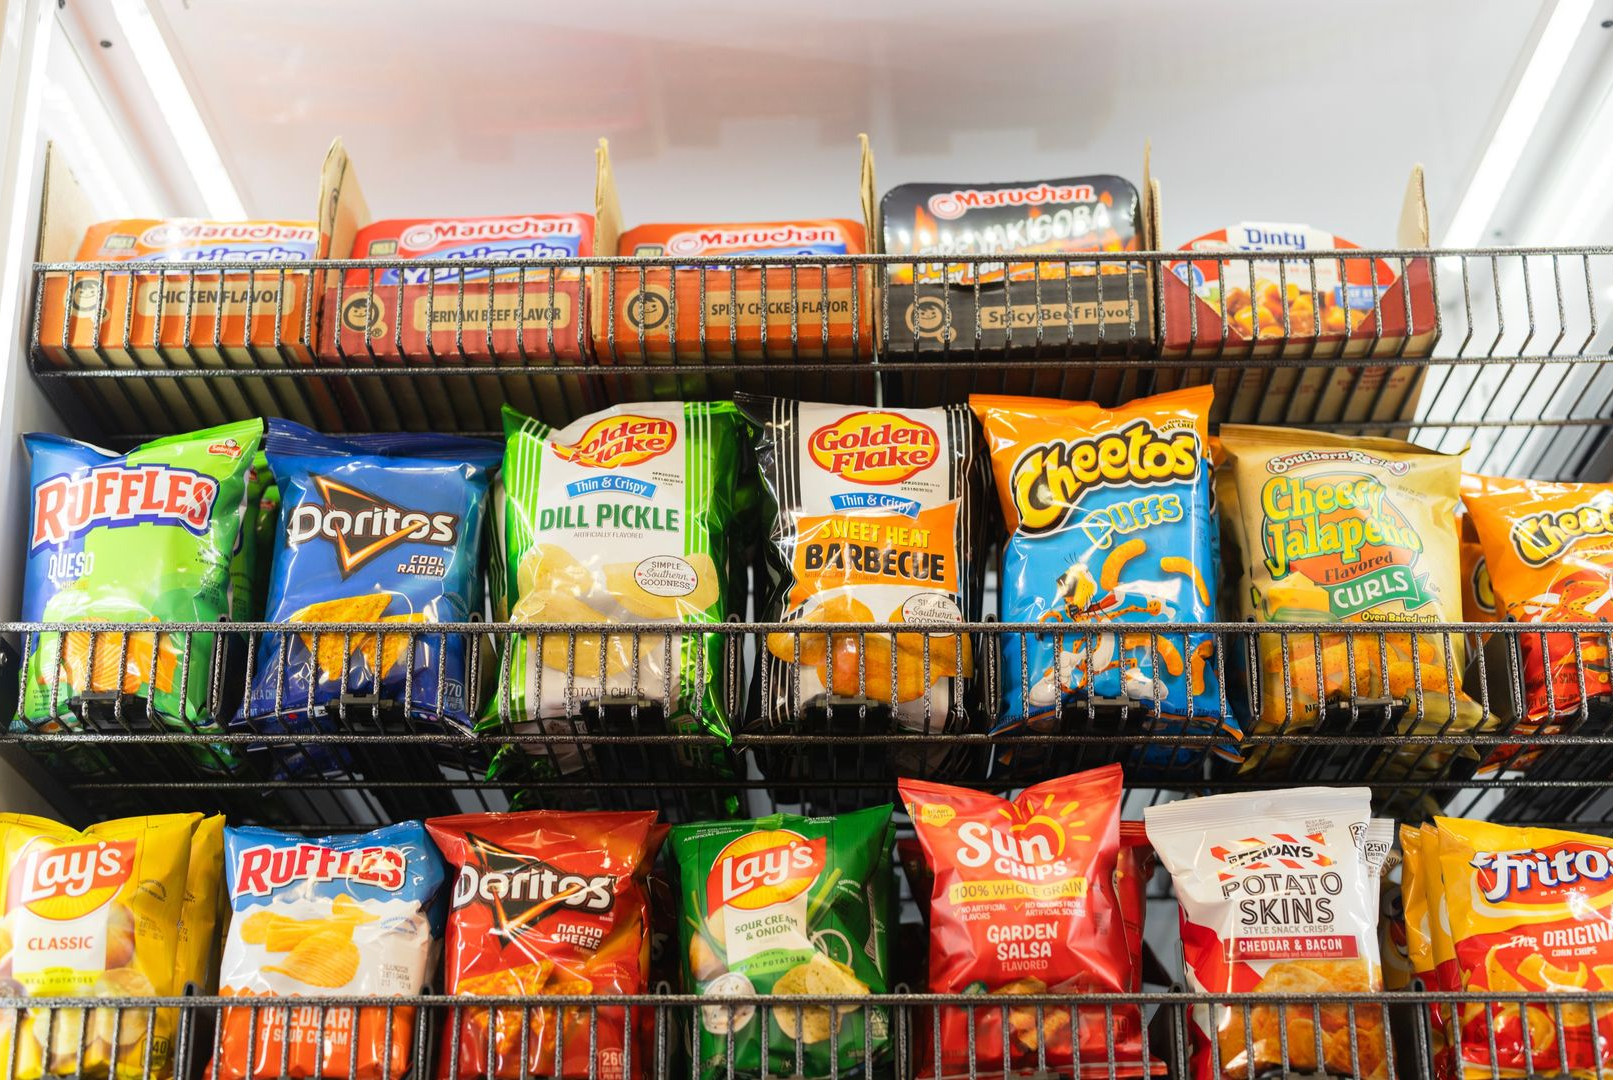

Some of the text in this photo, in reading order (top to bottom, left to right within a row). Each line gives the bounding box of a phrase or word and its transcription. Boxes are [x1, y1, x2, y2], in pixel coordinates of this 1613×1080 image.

[955, 185, 1091, 206] Maruchan
[181, 224, 314, 241] Maruchan
[435, 221, 573, 238] Maruchan
[700, 228, 836, 245] Maruchan
[1244, 228, 1306, 250] Dinty
[425, 310, 479, 323] ERIYAKI
[481, 309, 511, 322] BEEF
[711, 303, 745, 316] SPIY
[989, 306, 1131, 325] Spicy Beef Flvor
[574, 420, 669, 459] olden
[814, 423, 932, 451] Golden
[829, 446, 931, 474] Flake
[1270, 450, 1350, 473] Southern
[575, 480, 598, 493] Thin
[601, 476, 612, 488] &
[614, 477, 648, 495] Crispy
[1016, 424, 1197, 529] Cheetos
[34, 470, 215, 543] RUFFLES
[840, 495, 914, 515] Thin & Crispy
[1262, 476, 1386, 521] Cheesy
[289, 505, 455, 543] Doritos
[539, 503, 680, 533] DILL PICKLE
[573, 531, 643, 540] ARTIFICIALLY FLAVORED
[819, 519, 931, 549] SWEET HEAT
[48, 551, 95, 588] QUESO
[397, 563, 446, 577] RANCH
[410, 554, 445, 567] COOL
[804, 543, 946, 582] BARBECUE
[1324, 551, 1393, 582] Flavored
[1333, 571, 1410, 609] CURLS
[1361, 611, 1440, 623] Oven Baked with
[563, 687, 607, 698] POTAT
[956, 821, 1055, 867] Sun
[1366, 843, 1387, 853] 250
[1237, 844, 1314, 866] FRIDAYS
[20, 841, 122, 904] Lay's
[236, 844, 406, 895] RUFFLES
[722, 841, 813, 902] Lay's
[994, 856, 1068, 880] CHIPS
[452, 866, 615, 909] Doritos
[953, 881, 1082, 899] 100% WHOLE GRAIN
[1221, 871, 1343, 900] POTATO
[1540, 886, 1586, 897] BRAND
[961, 904, 1007, 914] NO ARTIFICIAL
[961, 913, 991, 922] FLAVORS
[1025, 909, 1061, 917] ARTIFICIAL
[1240, 897, 1335, 925] SKINS
[557, 923, 603, 938] NACHO
[735, 913, 798, 935] SOUR CREAM
[746, 923, 792, 941] & ONION
[987, 921, 1059, 944] GARDEN
[1243, 924, 1335, 934] STYLE SNACK CRISPS
[28, 935, 94, 951] CLASSIC
[551, 932, 601, 950] CHEESE
[1239, 938, 1343, 952] CHEDDAR & BACON
[1510, 934, 1538, 949] The
[997, 942, 1052, 961] SALSA
[1551, 946, 1597, 957] CORN CHIPS
[1001, 960, 1049, 971] FLAVORED
[602, 1051, 625, 1066] 260
